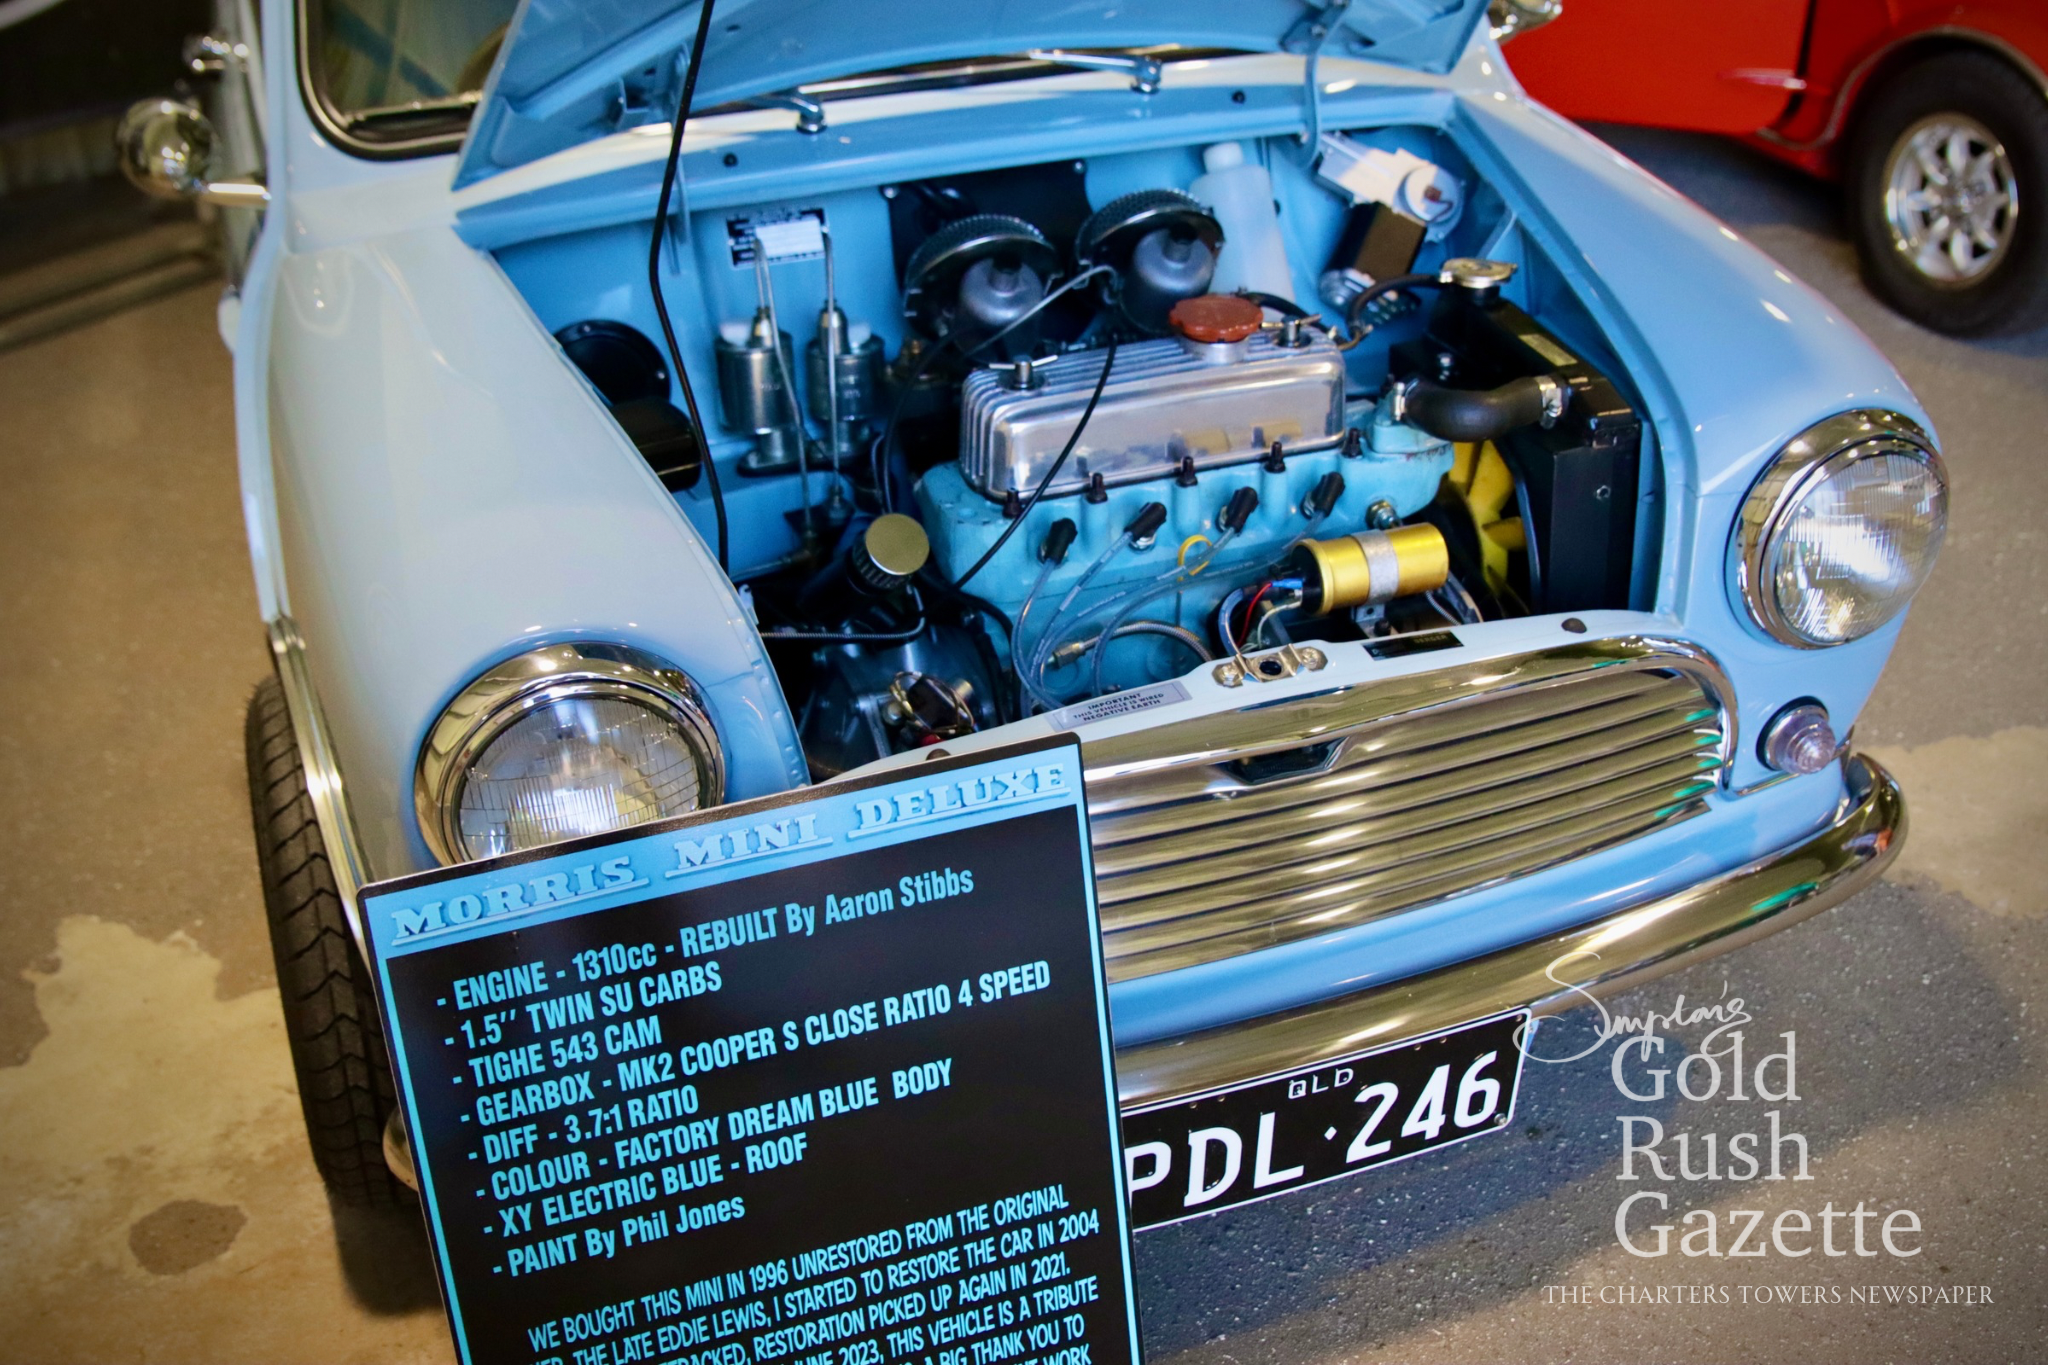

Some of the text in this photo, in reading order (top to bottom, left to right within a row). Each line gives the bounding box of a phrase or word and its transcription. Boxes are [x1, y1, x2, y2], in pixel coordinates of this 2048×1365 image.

[1073, 710, 1092, 719] THIS
[1094, 702, 1127, 713] VEHICLE
[1139, 693, 1164, 702] WIRED
[1083, 699, 1161, 721] NEGATIVE EARTH
[1088, 693, 1141, 710] IMPORTANT
[391, 763, 1066, 938] MORRIS MINI DELUXE
[453, 960, 549, 1011] ENGINE
[571, 942, 657, 982] 1310cc
[679, 906, 778, 958] REBUILT
[784, 902, 816, 937] By
[825, 887, 895, 926] Aaron
[898, 866, 975, 908] Stibbs
[525, 990, 595, 1034] TWIN
[599, 981, 634, 1017] SU
[638, 960, 723, 1008] CARBS
[468, 1042, 546, 1088] TIGHE
[549, 1030, 599, 1069] 543
[603, 1014, 663, 1056] CAM
[476, 1070, 596, 1126] GEARBOX
[617, 1051, 676, 1092] MK2
[680, 1026, 778, 1076] COOPER
[782, 1020, 800, 1051] S
[804, 1000, 880, 1046] CLOSE
[882, 983, 952, 1027] RATIO
[957, 978, 974, 1008] 4
[978, 959, 1051, 1004] SPEED
[1288, 1067, 1354, 1099] QLD
[482, 1123, 539, 1164] DIFF
[564, 1103, 624, 1144] 3.7:1
[626, 1084, 699, 1128] RATIO
[491, 1150, 592, 1201] COLOUR
[614, 1116, 720, 1170] FACTORY
[727, 1092, 815, 1141] DREAM
[818, 1076, 880, 1118] BLUE
[891, 1057, 953, 1100] BODY
[498, 1202, 532, 1237] XY
[541, 1171, 657, 1226] ELECTRIC
[661, 1153, 724, 1196] BLUE
[744, 1131, 808, 1174] ROOF
[507, 1232, 578, 1277] PAINT
[584, 1227, 615, 1259] By
[621, 1209, 670, 1247] Phil
[675, 1196, 746, 1234] Jones
[527, 1183, 1070, 1353] WE BOUGHT THIS MINI IN 1996 UNRESTORED FROM THE ORIGINAL
[611, 1330, 655, 1365] LATE
[656, 1315, 711, 1354] EDDIE
[712, 1300, 772, 1339] LEWIS,
[773, 1295, 781, 1322] I
[783, 1276, 858, 1319] STARTED
[859, 1268, 884, 1297] TO
[886, 1246, 962, 1291] RESTORE
[962, 1236, 998, 1269] THE
[1000, 1227, 1035, 1259] CAR
[1036, 1220, 1055, 1249] IN
[1057, 1208, 1100, 1243] 2004
[752, 1307, 866, 1362] RESTORATION
[867, 1291, 927, 1330] PICKED
[929, 1283, 953, 1312] UP
[958, 1267, 1007, 1306] AGAIN
[1009, 1261, 1028, 1291] IN
[1030, 1250, 1071, 1285] 2021.
[886, 1325, 925, 1358] THIS
[927, 1304, 996, 1346] VEHICLE
[997, 1299, 1015, 1327] IS
[1019, 1295, 1032, 1322] A
[1032, 1274, 1099, 1316] TRIBUTE
[970, 1329, 1026, 1365] THANK
[1026, 1319, 1060, 1351] YOU
[1062, 1312, 1085, 1341] TO
